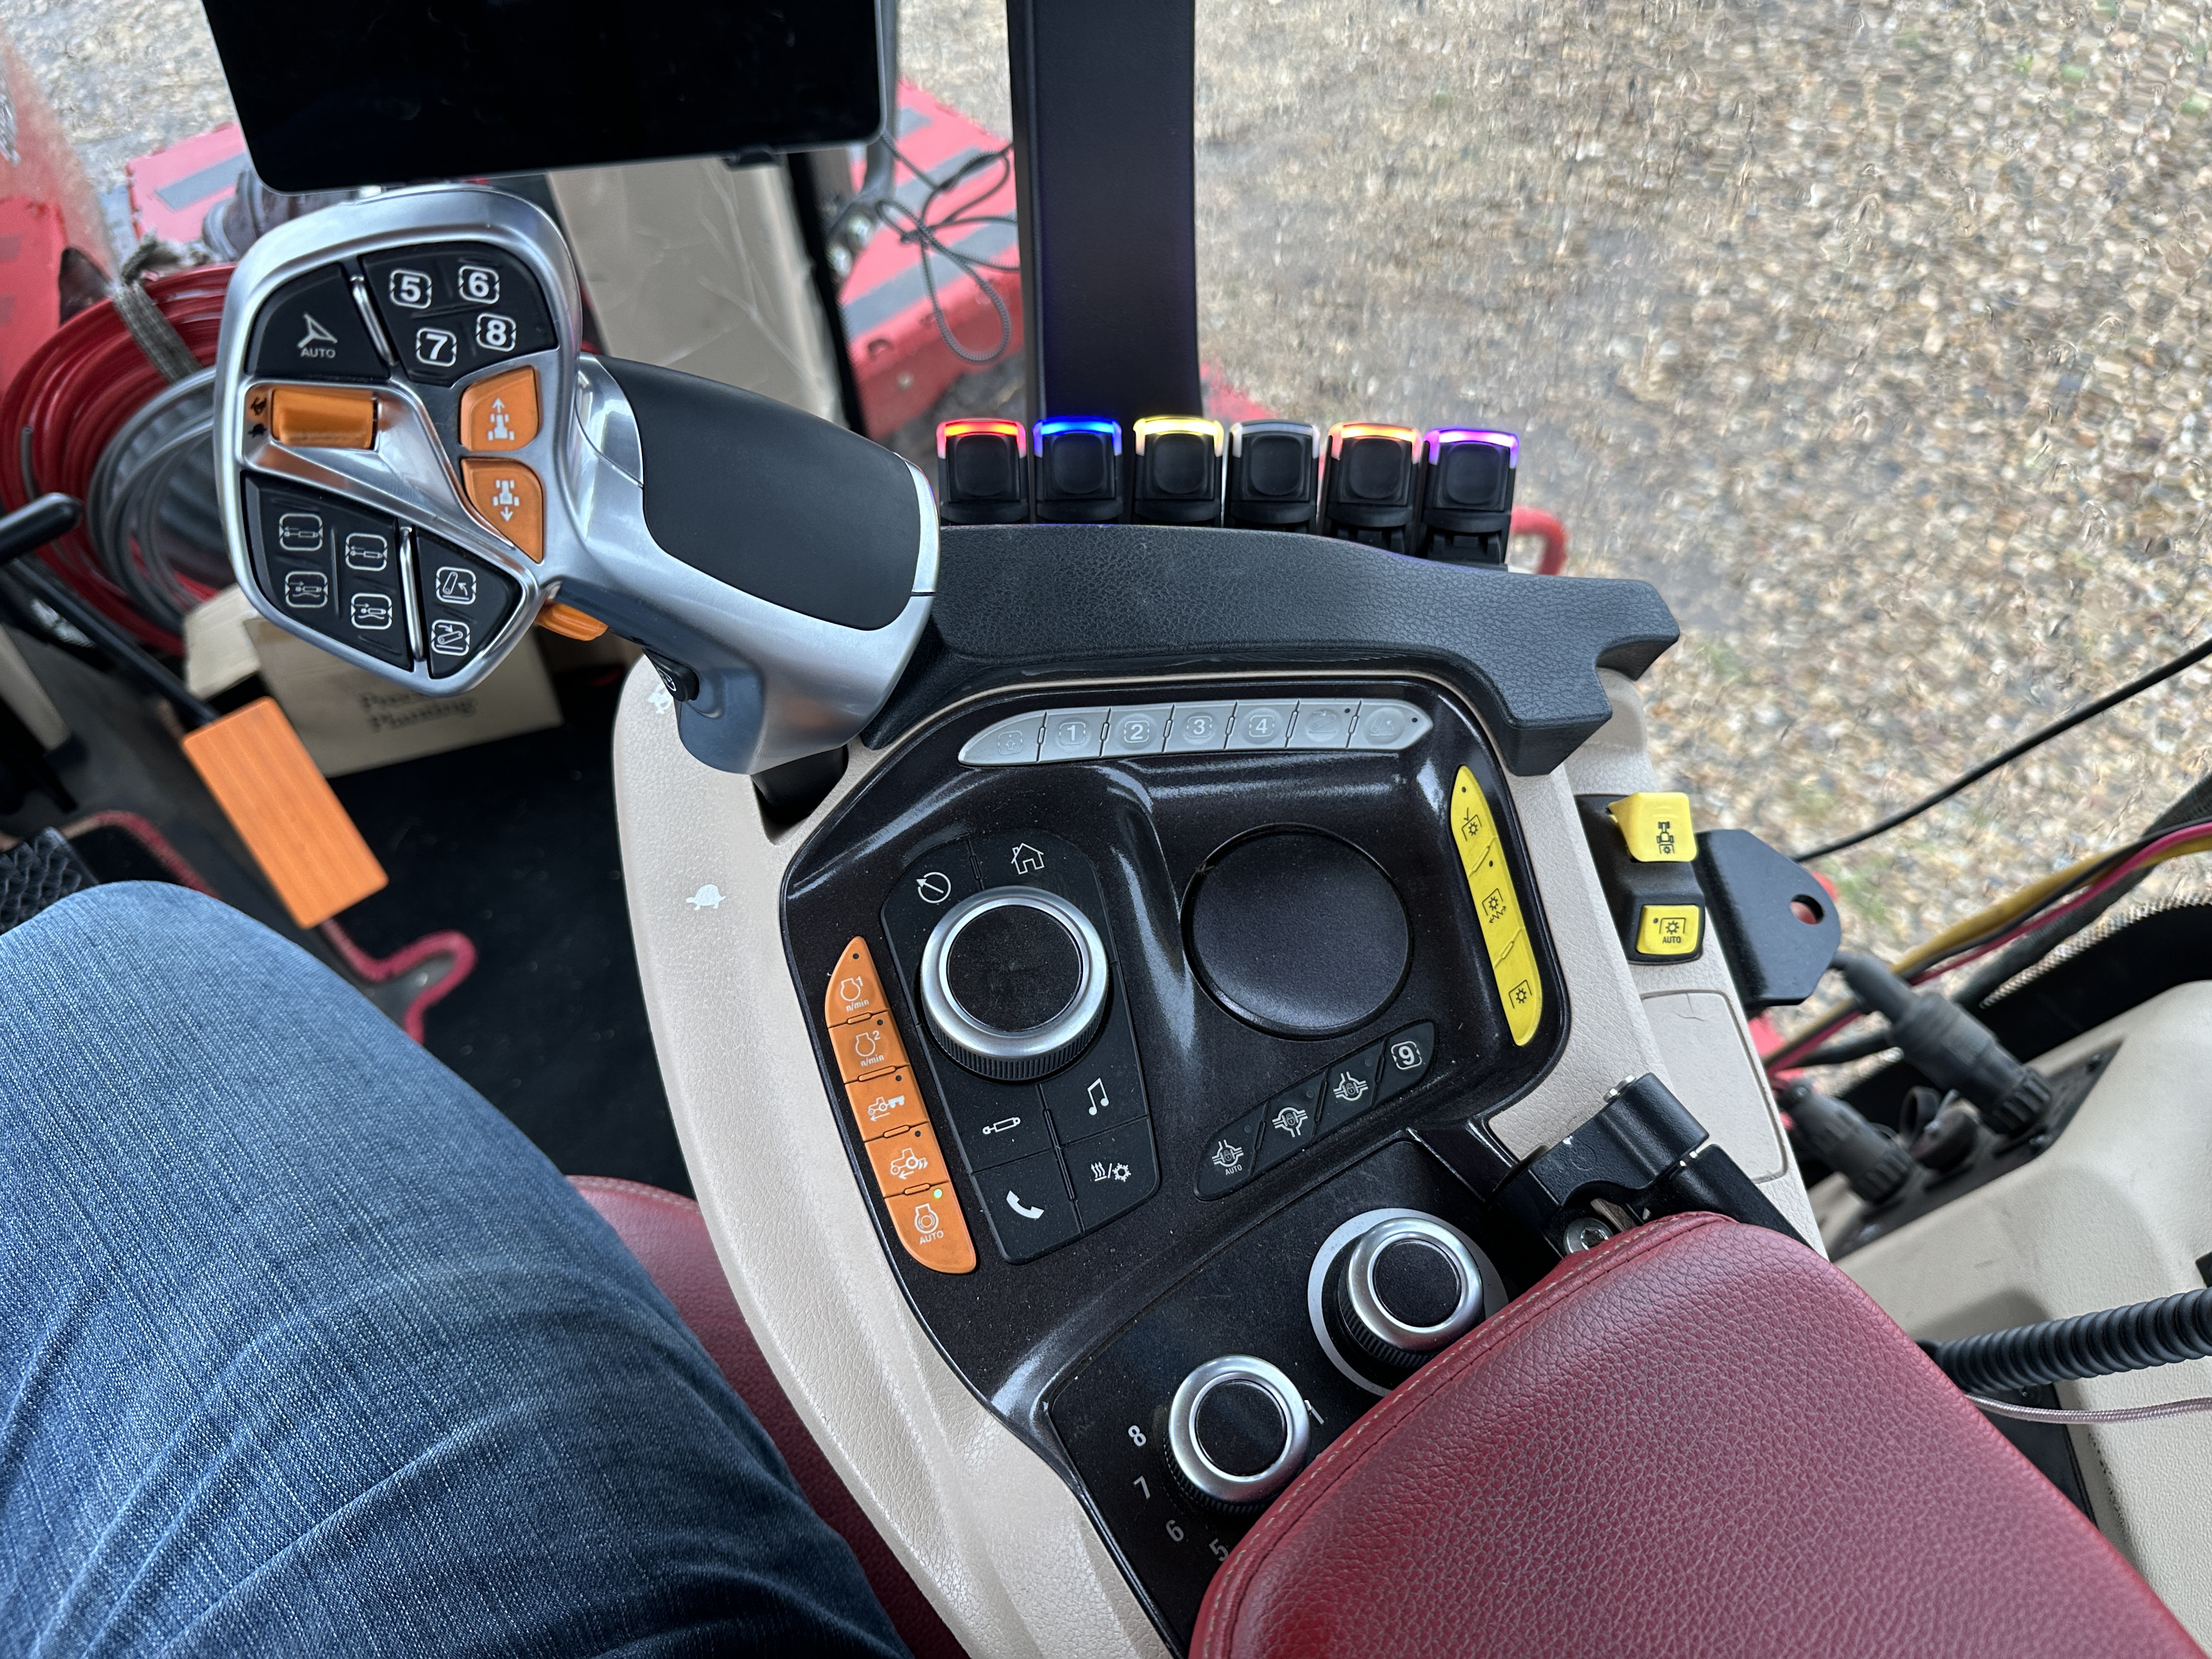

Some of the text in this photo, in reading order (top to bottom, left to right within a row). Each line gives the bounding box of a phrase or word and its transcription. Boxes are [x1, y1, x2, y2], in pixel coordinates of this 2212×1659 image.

[400, 275, 421, 303] 5
[469, 272, 489, 298] 6
[487, 319, 507, 347] 8
[300, 347, 336, 359] AUTO
[426, 334, 445, 362] 7
[1066, 725, 1076, 741] 1
[1130, 724, 1143, 740] 2
[1193, 719, 1205, 735] 3
[1255, 718, 1268, 734] 4
[1662, 936, 1681, 944] AUTO
[856, 975, 864, 987] 1
[845, 998, 870, 1012] n/min
[872, 1030, 881, 1041] 2
[860, 1053, 885, 1067] n/min
[1398, 1046, 1415, 1065] 9
[1224, 1165, 1243, 1176] AUTO
[918, 1229, 944, 1245] AUTO
[1128, 1425, 1147, 1447] 8
[1133, 1476, 1150, 1499] 7
[1166, 1520, 1184, 1542] 6
[1209, 1538, 1229, 1562] 5
